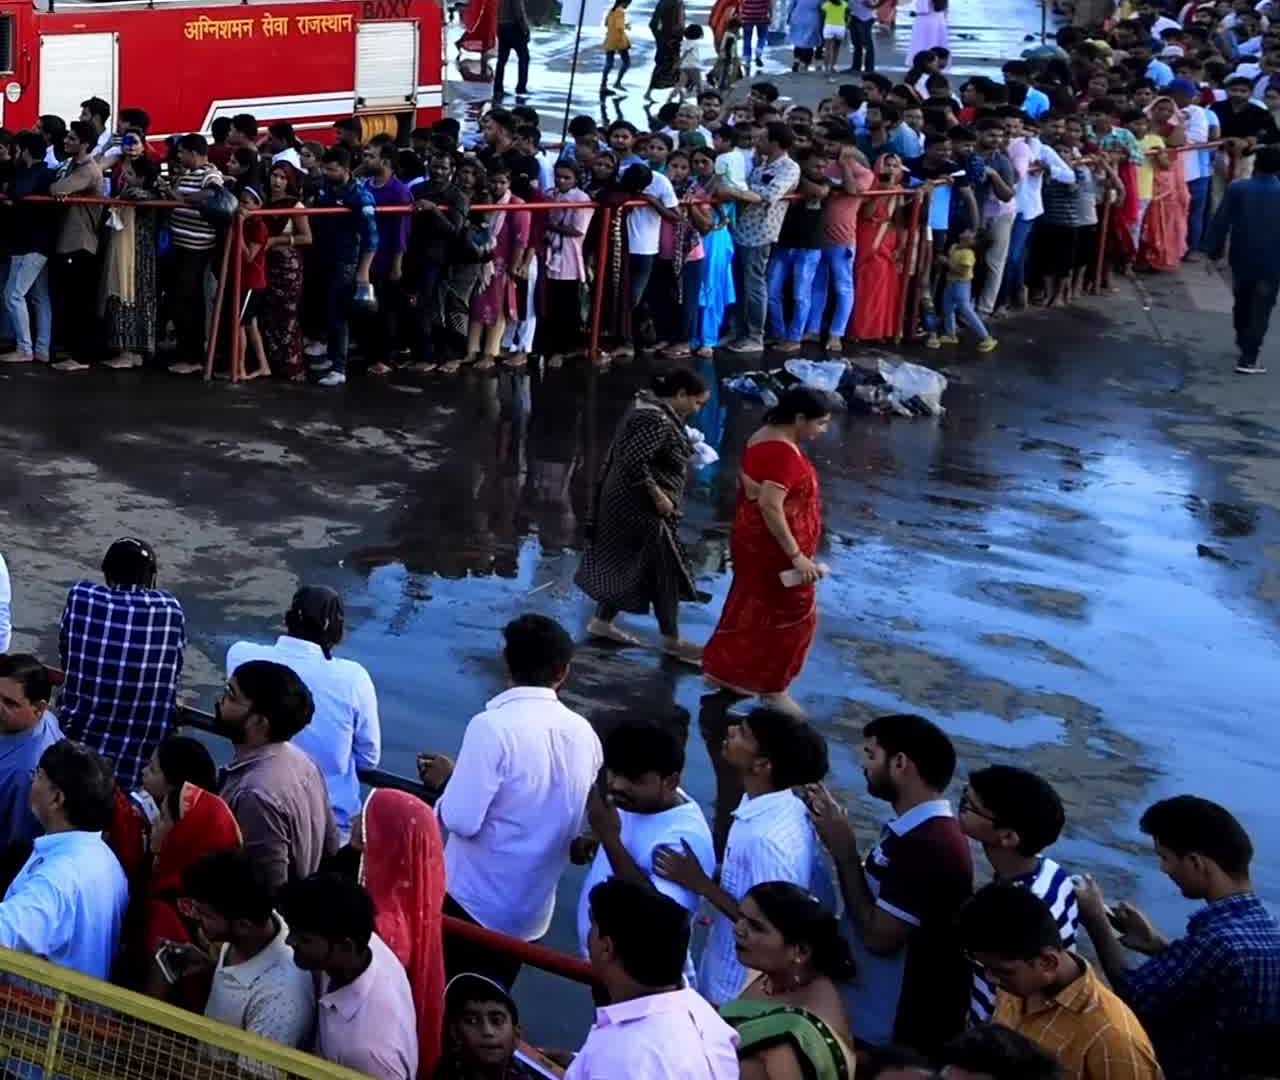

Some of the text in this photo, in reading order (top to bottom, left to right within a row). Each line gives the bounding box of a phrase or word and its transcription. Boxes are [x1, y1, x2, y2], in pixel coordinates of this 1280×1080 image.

[183, 11, 354, 41] अग्निशमन सेवा राजस्थान
